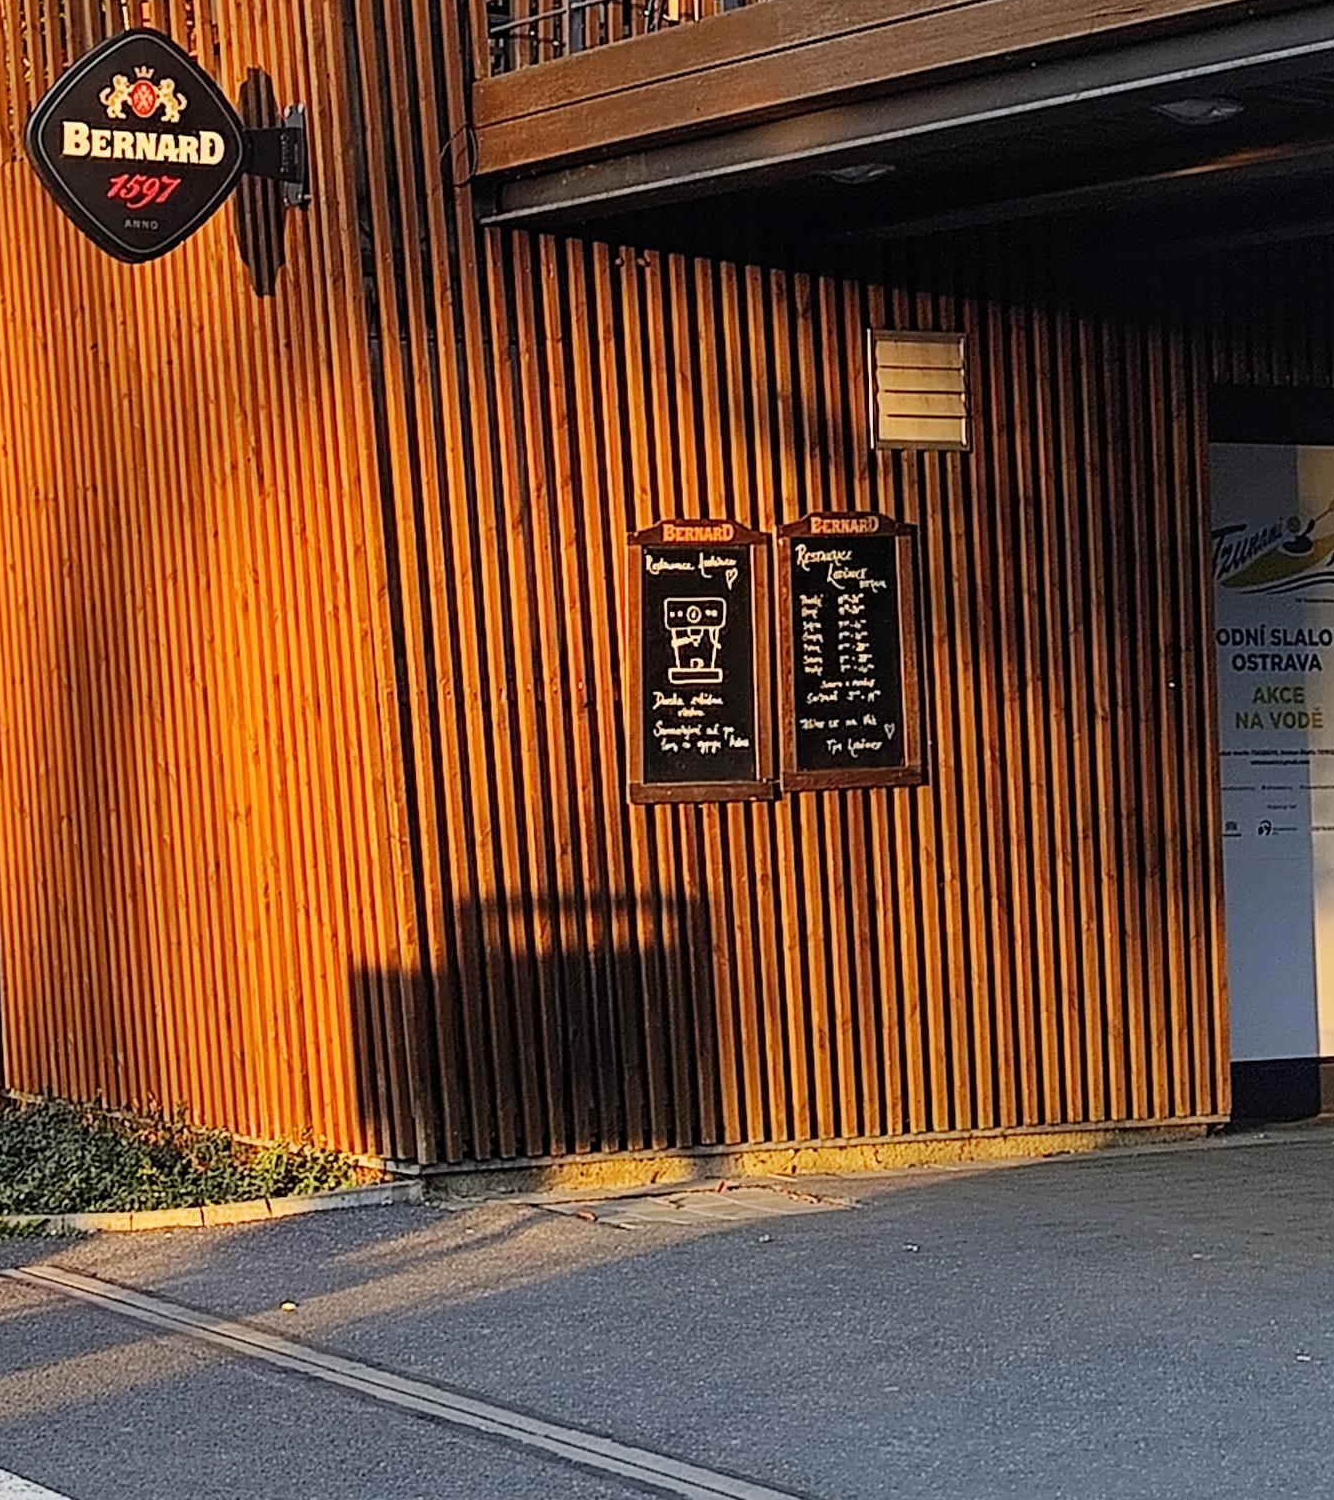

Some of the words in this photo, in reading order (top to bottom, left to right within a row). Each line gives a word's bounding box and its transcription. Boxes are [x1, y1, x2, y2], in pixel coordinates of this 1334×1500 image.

[62, 120, 226, 166] BERNARD
[107, 173, 182, 210] 1597
[124, 218, 159, 231] ANNO
[662, 523, 734, 542] BERNARD
[810, 516, 879, 534] BERNARD
[1231, 653, 1323, 672] OSTRAVA
[1252, 687, 1305, 704] AKCE
[1235, 712, 1264, 729] NA
[1269, 707, 1323, 729] VODĚ
